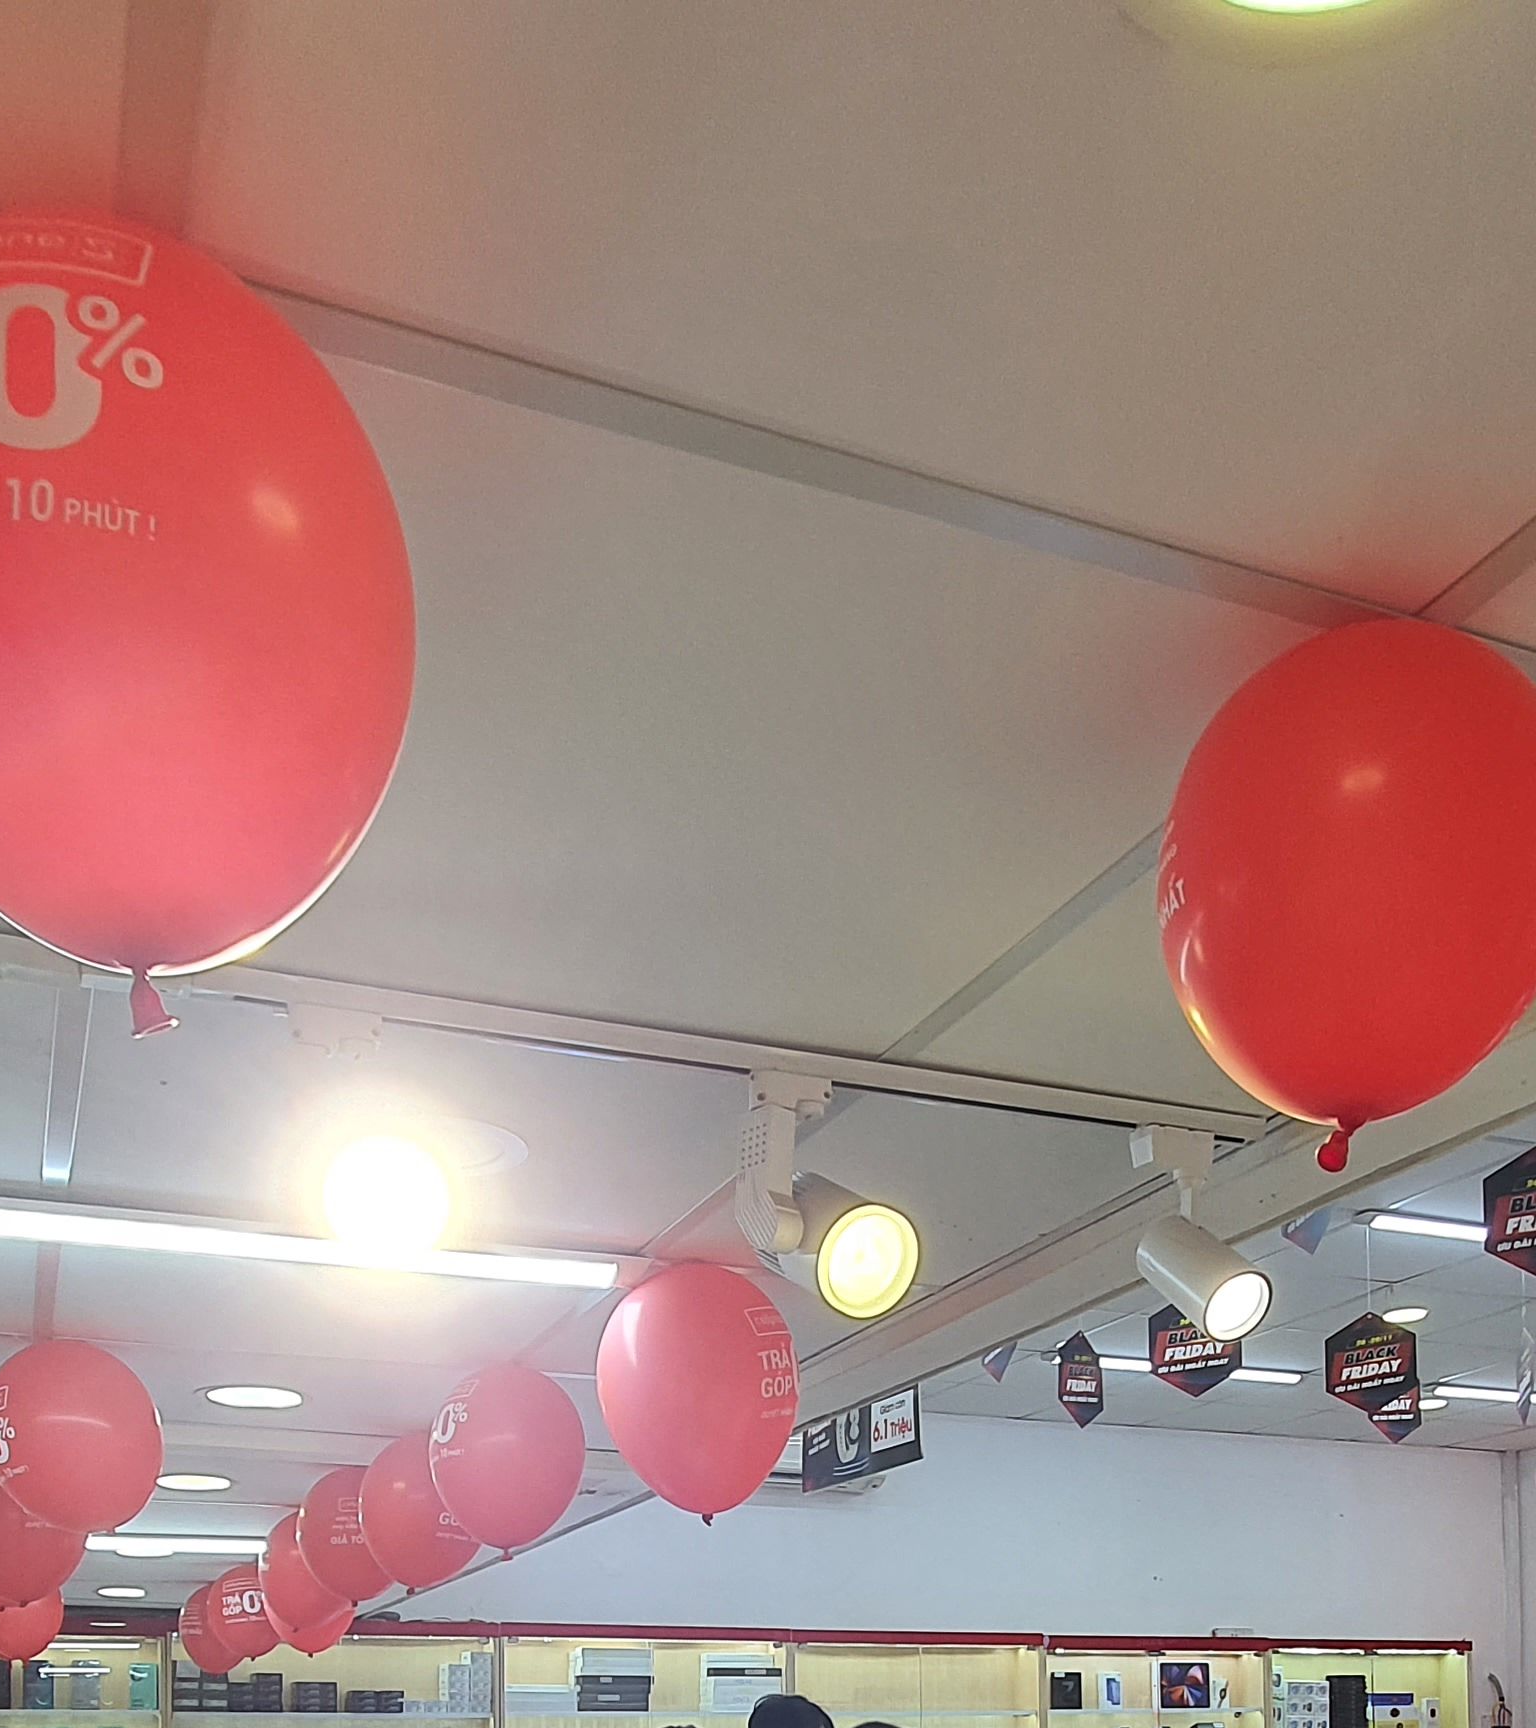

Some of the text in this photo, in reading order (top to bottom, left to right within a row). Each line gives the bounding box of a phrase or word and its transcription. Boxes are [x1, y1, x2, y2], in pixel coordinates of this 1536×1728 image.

[5, 477, 55, 522] 10
[757, 1343, 791, 1371] TRẢ
[1163, 1342, 1226, 1363] FRIDAY
[1342, 1344, 1398, 1366] BLACK
[1340, 1358, 1404, 1381] FRIDAY
[760, 1371, 793, 1399] GÓP
[1065, 1378, 1098, 1393] FRIDAY
[872, 1417, 913, 1442] 6.1 Triệu
